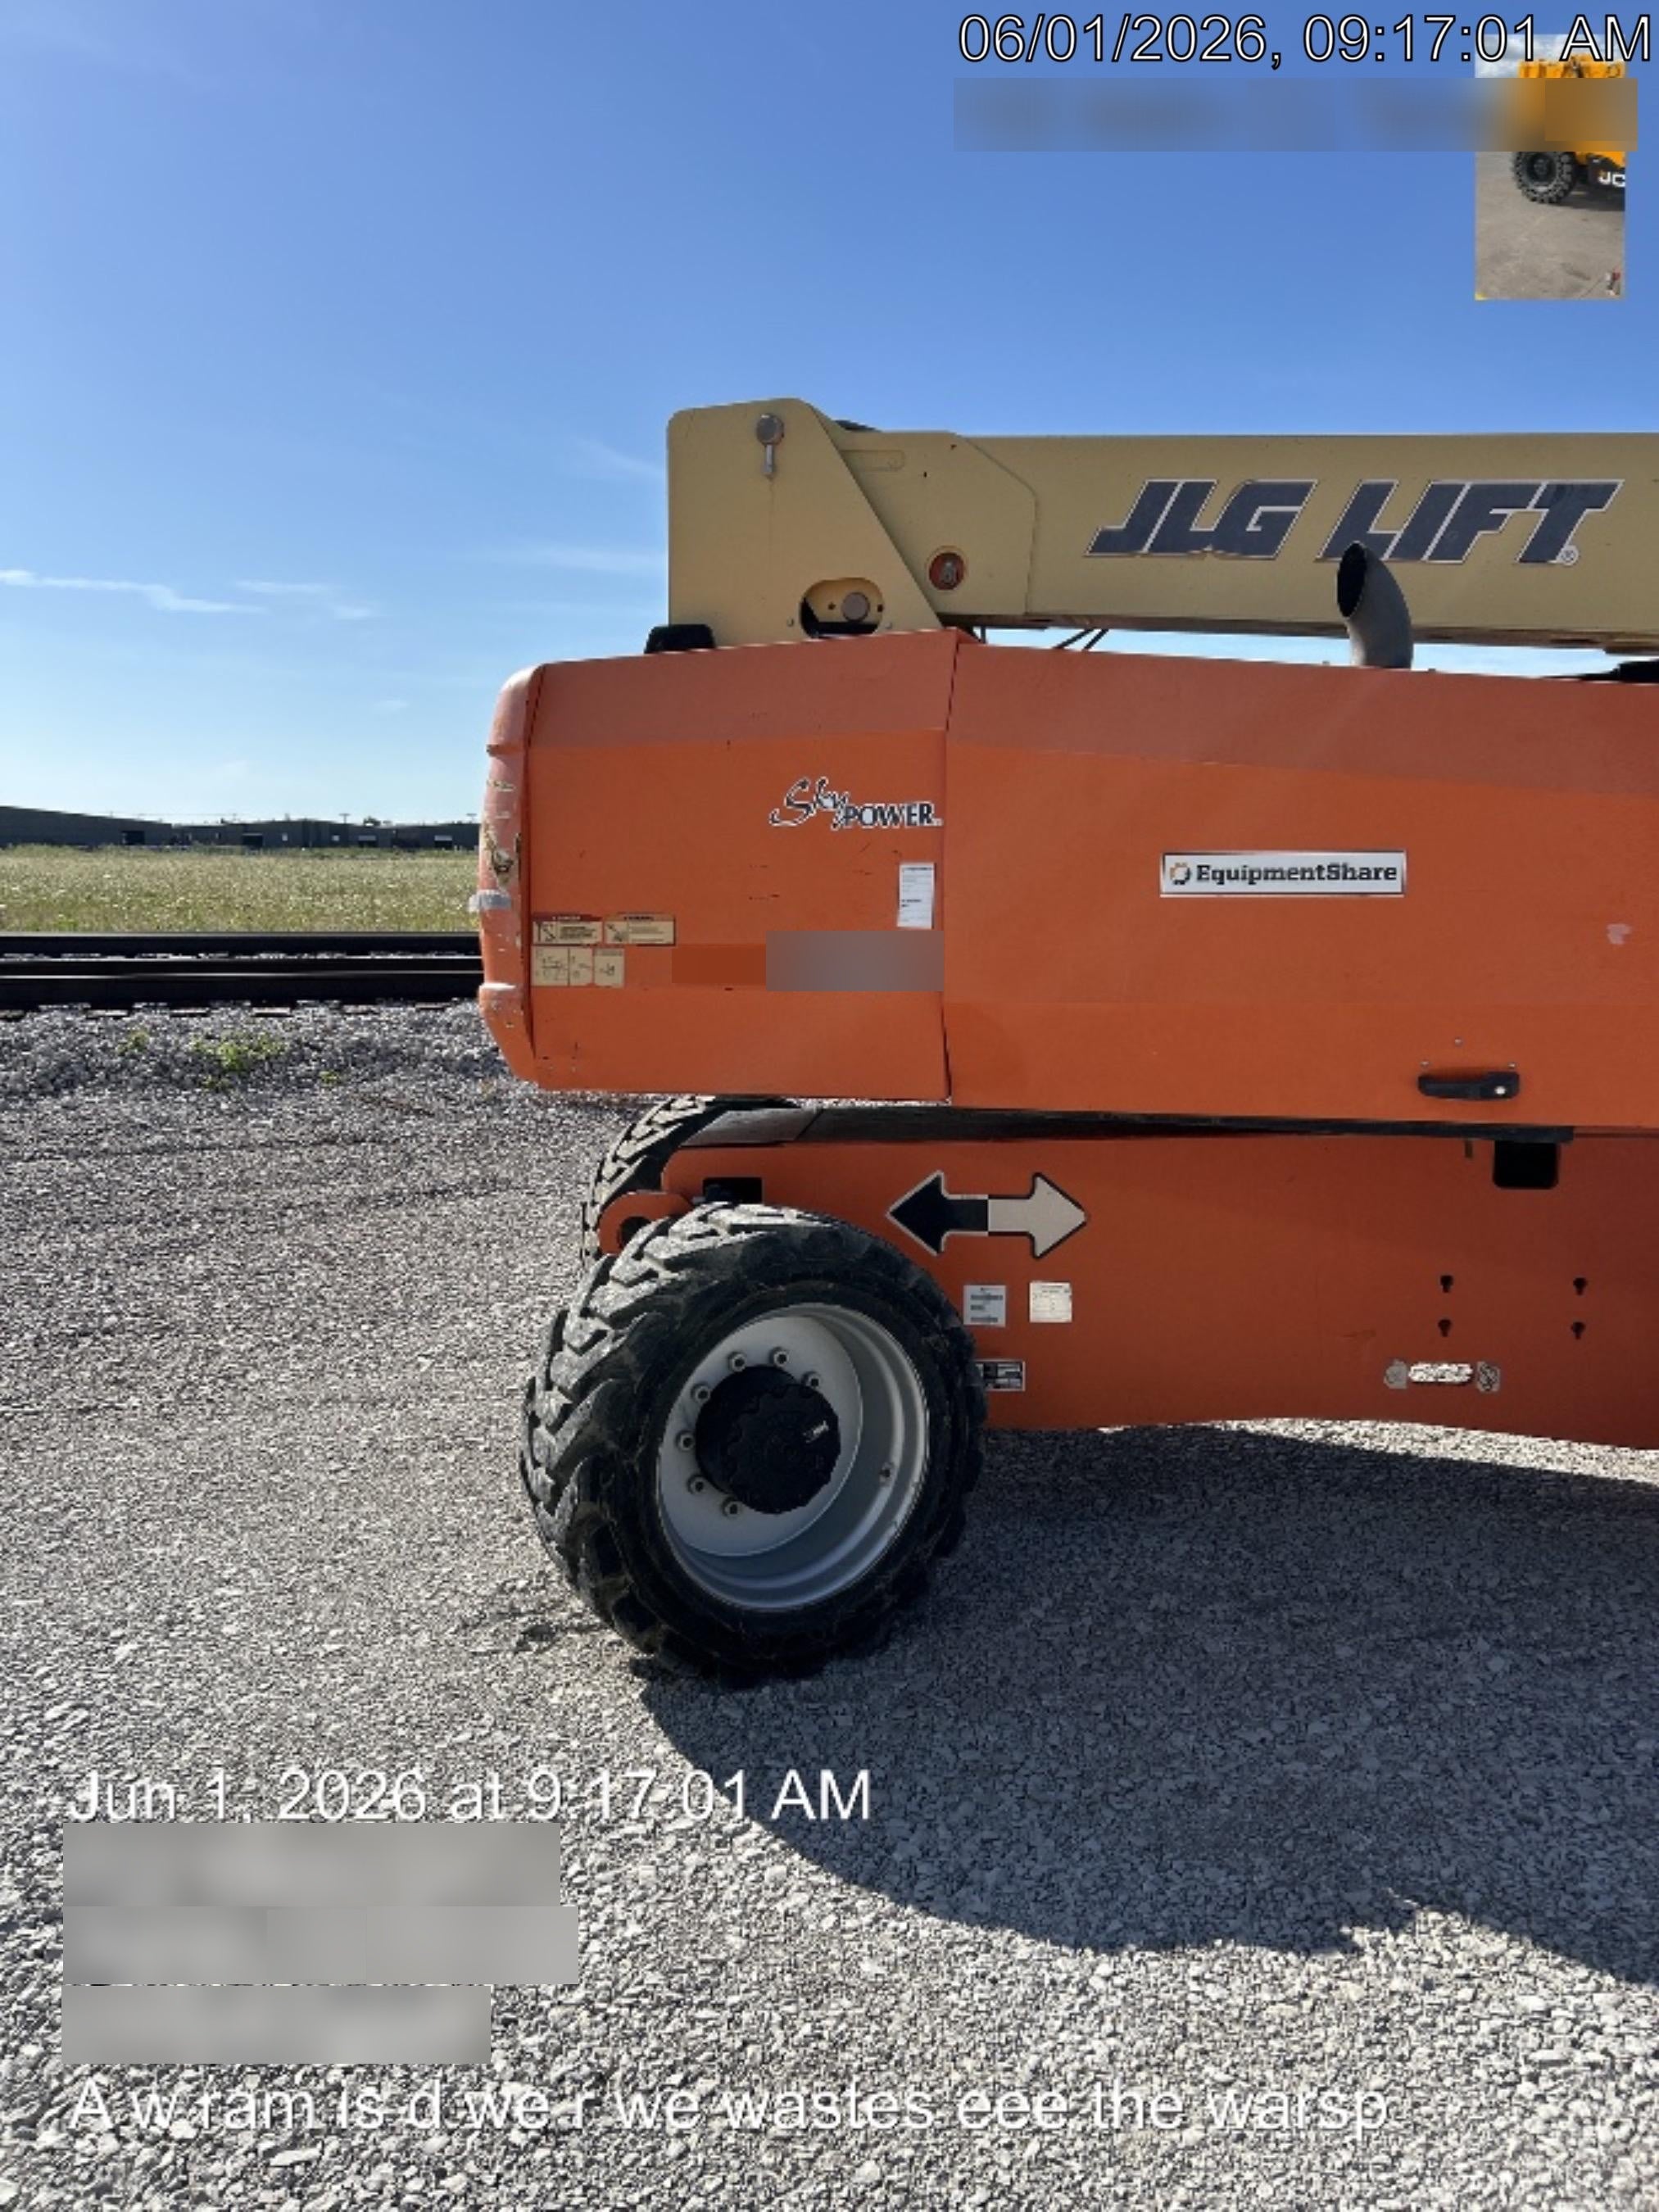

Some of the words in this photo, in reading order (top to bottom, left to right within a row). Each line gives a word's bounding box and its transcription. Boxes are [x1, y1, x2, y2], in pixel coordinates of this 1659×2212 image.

[1084, 478, 1318, 560] JLG
[1313, 478, 1625, 564] LIFT
[768, 777, 850, 831] Sky
[841, 801, 935, 828] POWER
[1196, 863, 1398, 885] EquipmentShare
